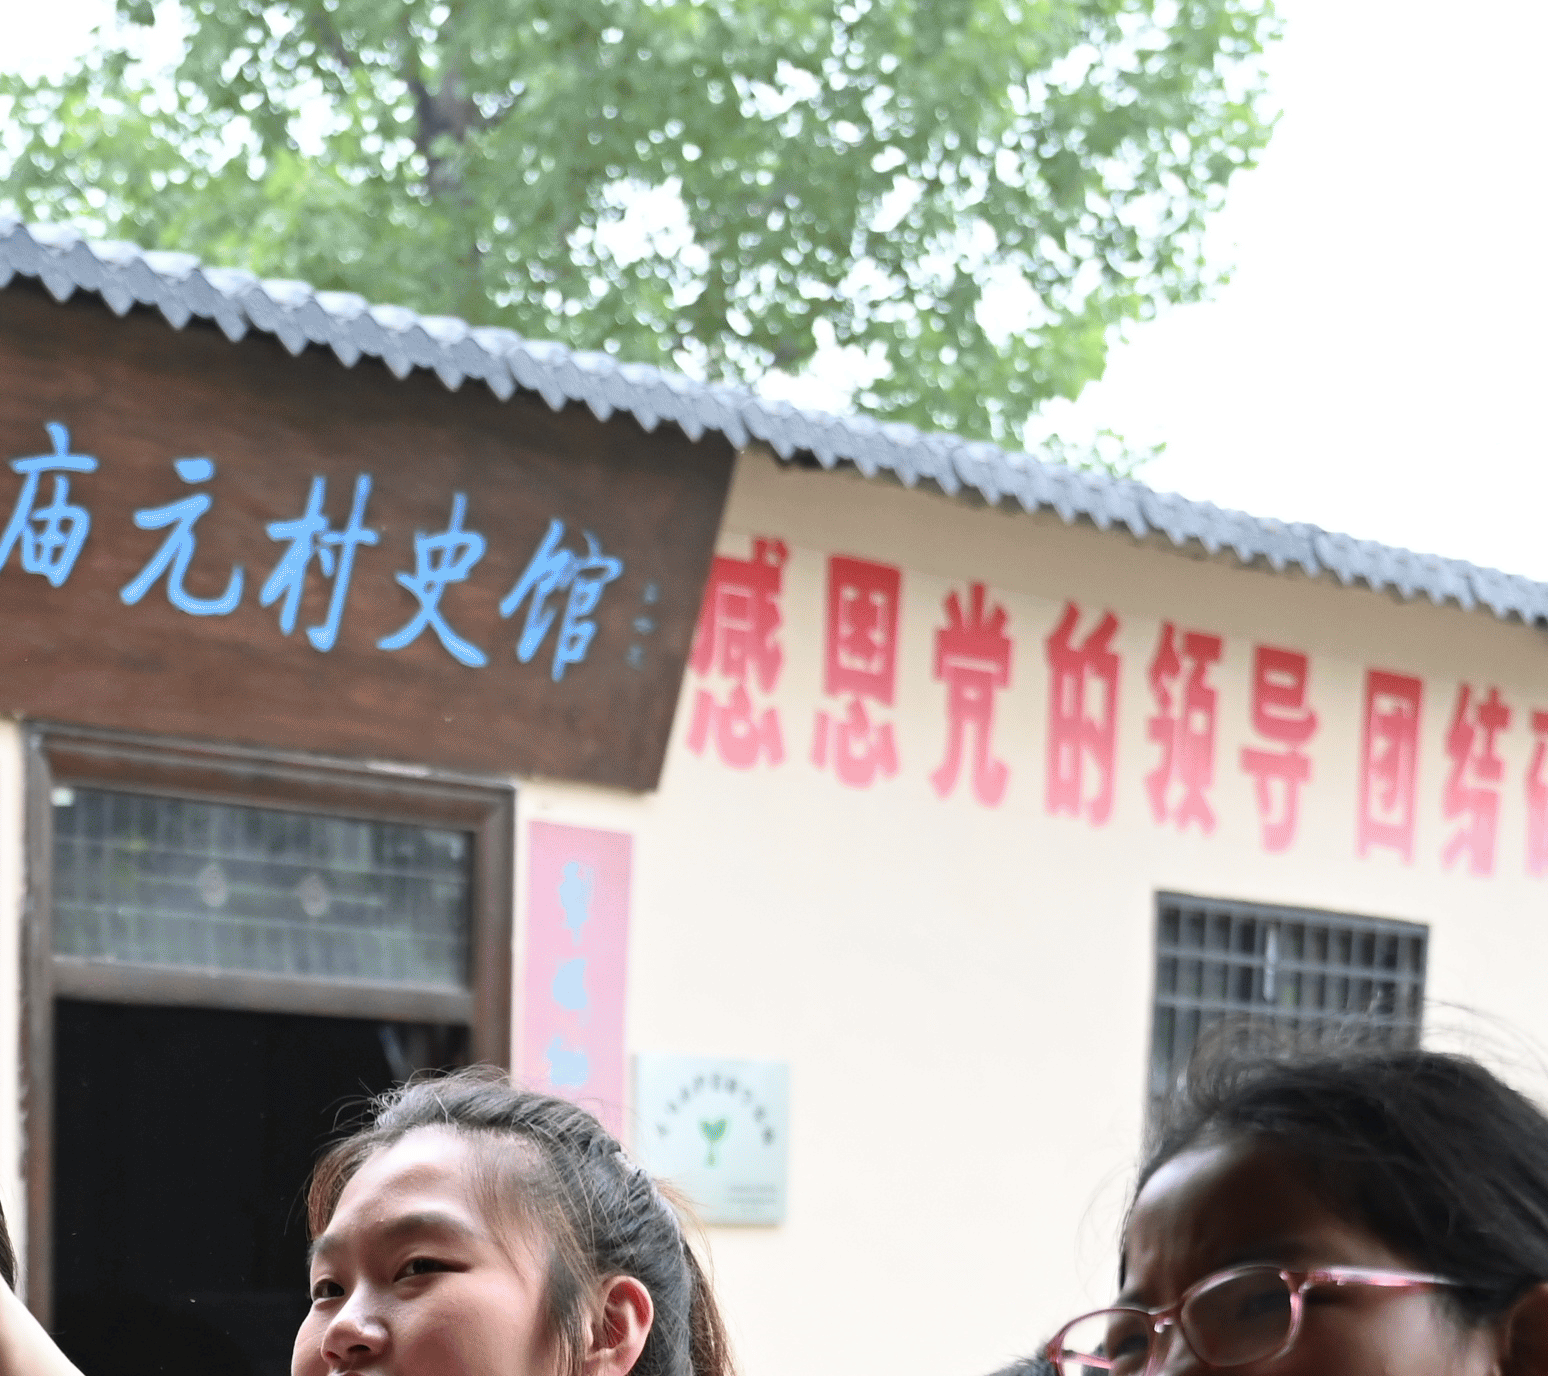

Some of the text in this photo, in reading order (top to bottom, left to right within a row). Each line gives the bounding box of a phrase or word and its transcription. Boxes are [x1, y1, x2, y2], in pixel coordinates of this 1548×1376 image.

[684, 536, 1319, 854] 感恩党的领导
